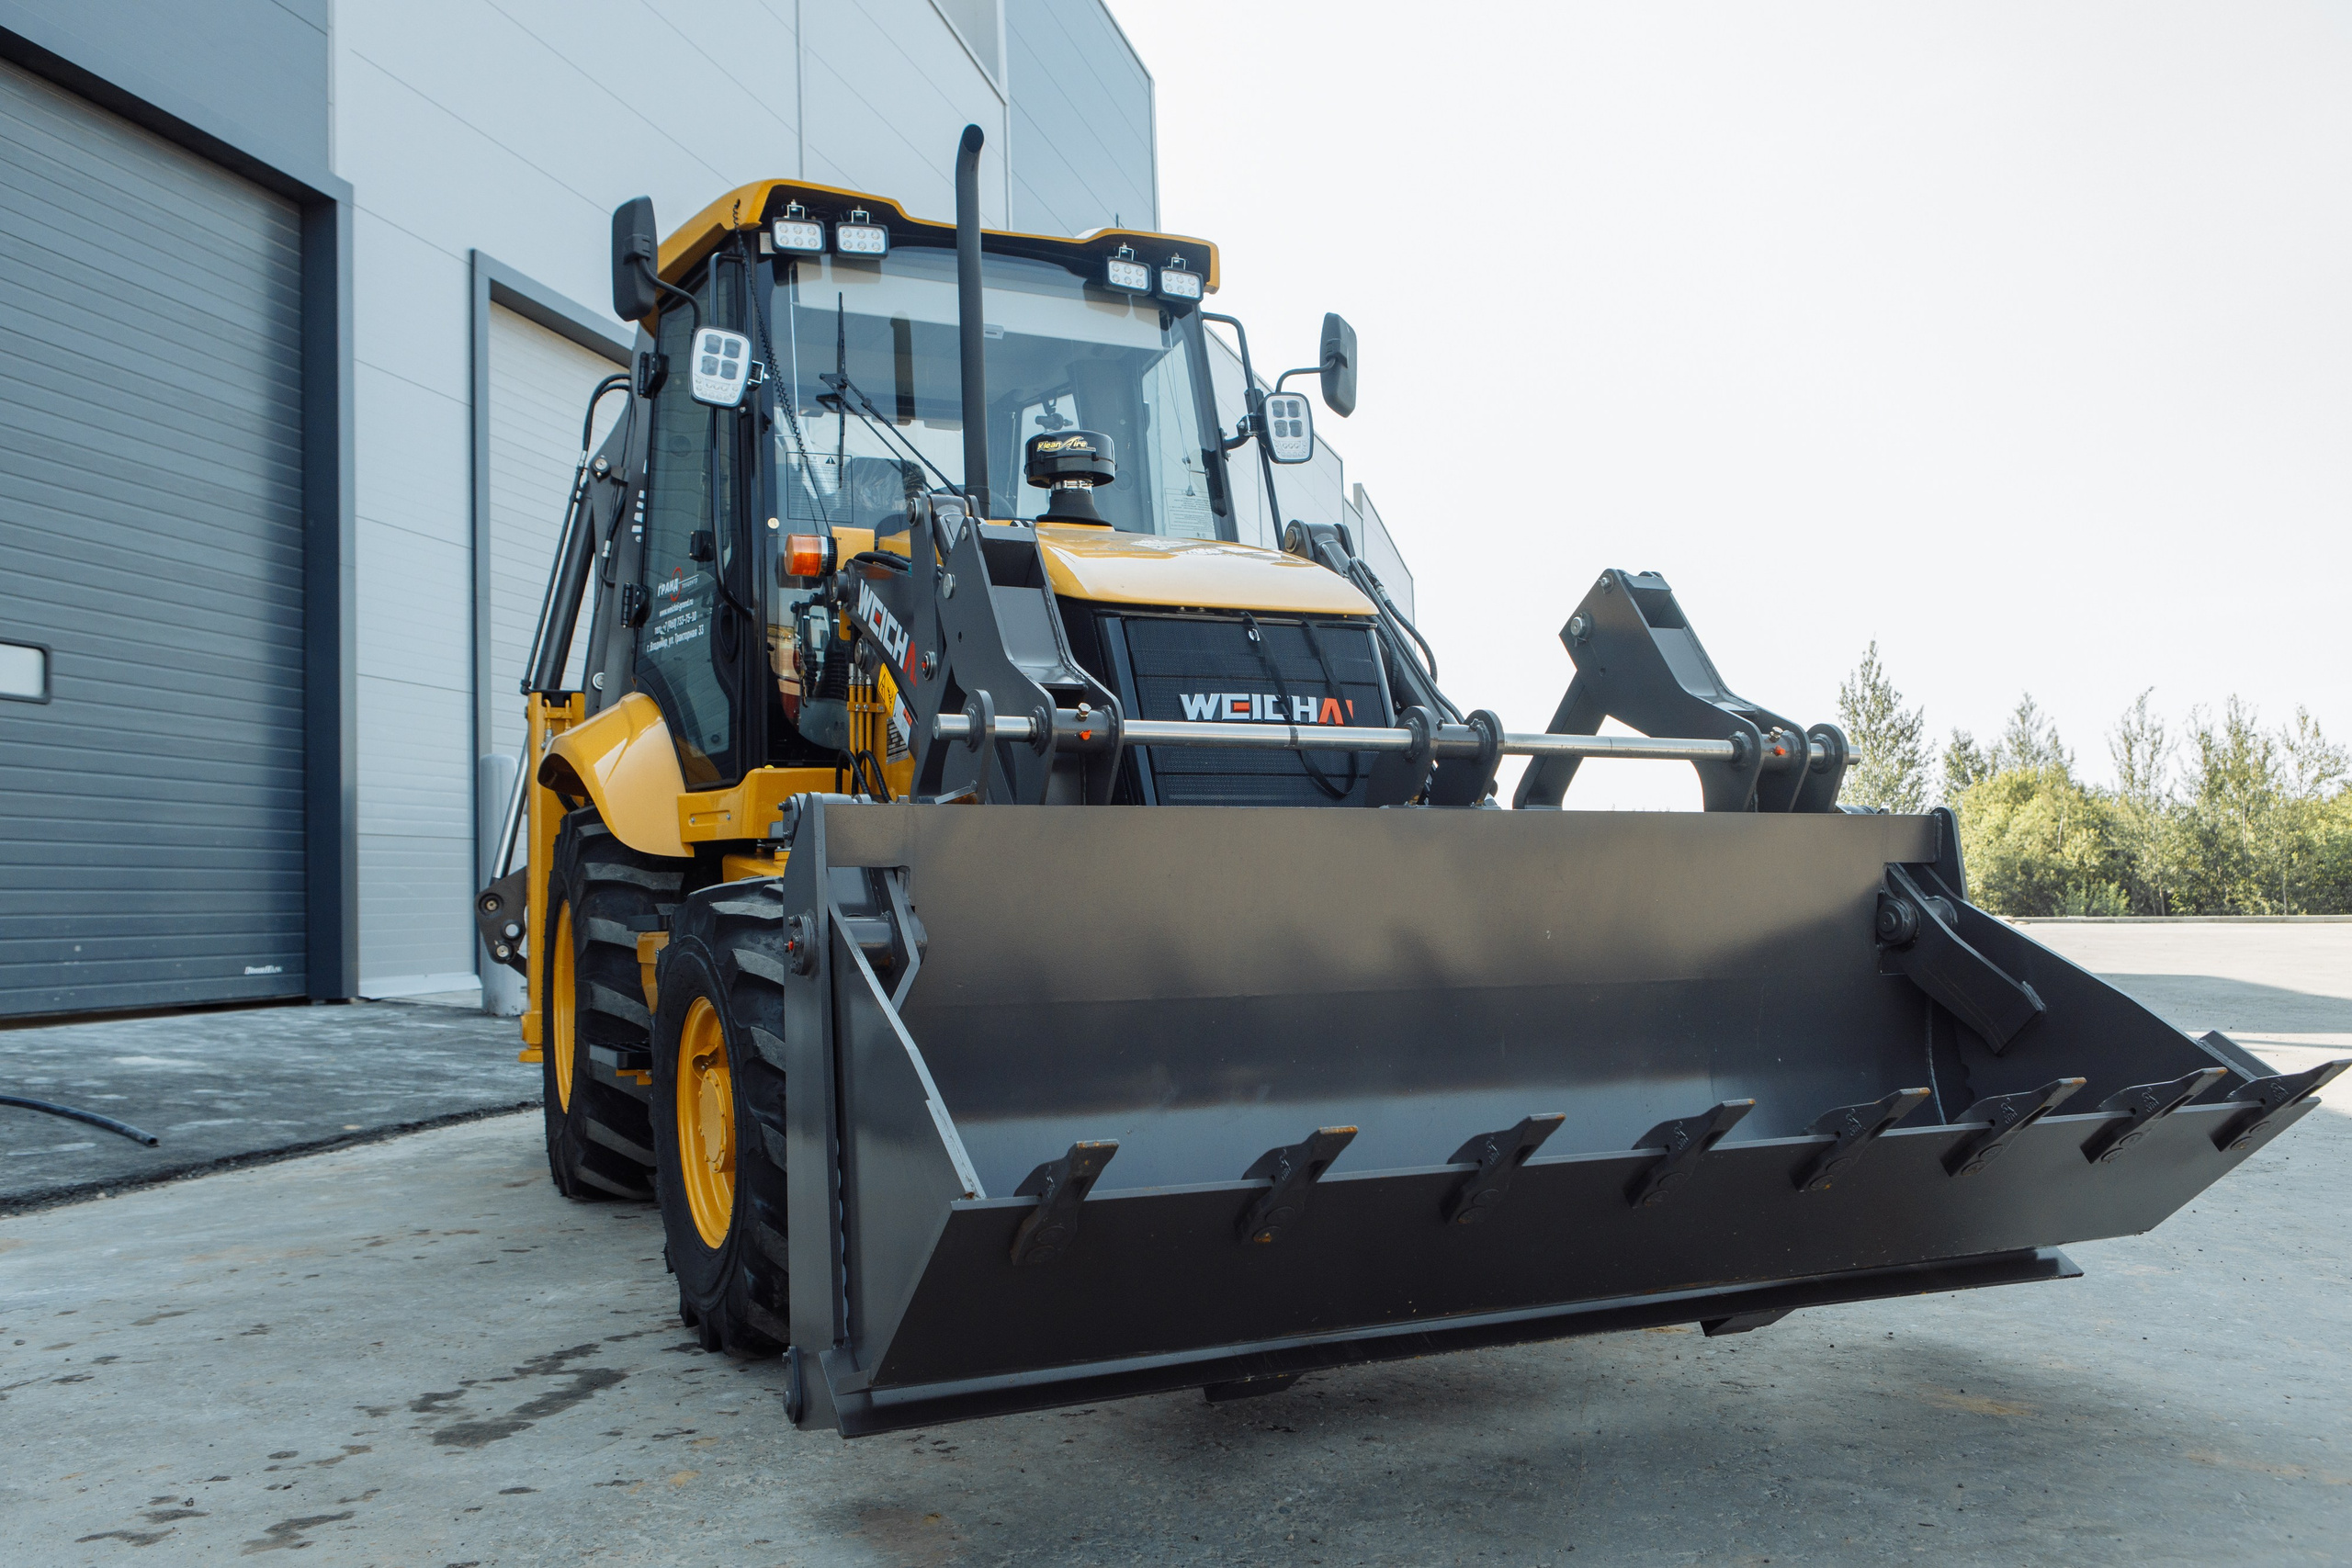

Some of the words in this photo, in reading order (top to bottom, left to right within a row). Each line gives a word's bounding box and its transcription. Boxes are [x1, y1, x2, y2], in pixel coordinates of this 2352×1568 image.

[657, 577, 679, 597] ГРАНД
[698, 624, 705, 636] 33
[857, 578, 917, 687] WEICHA
